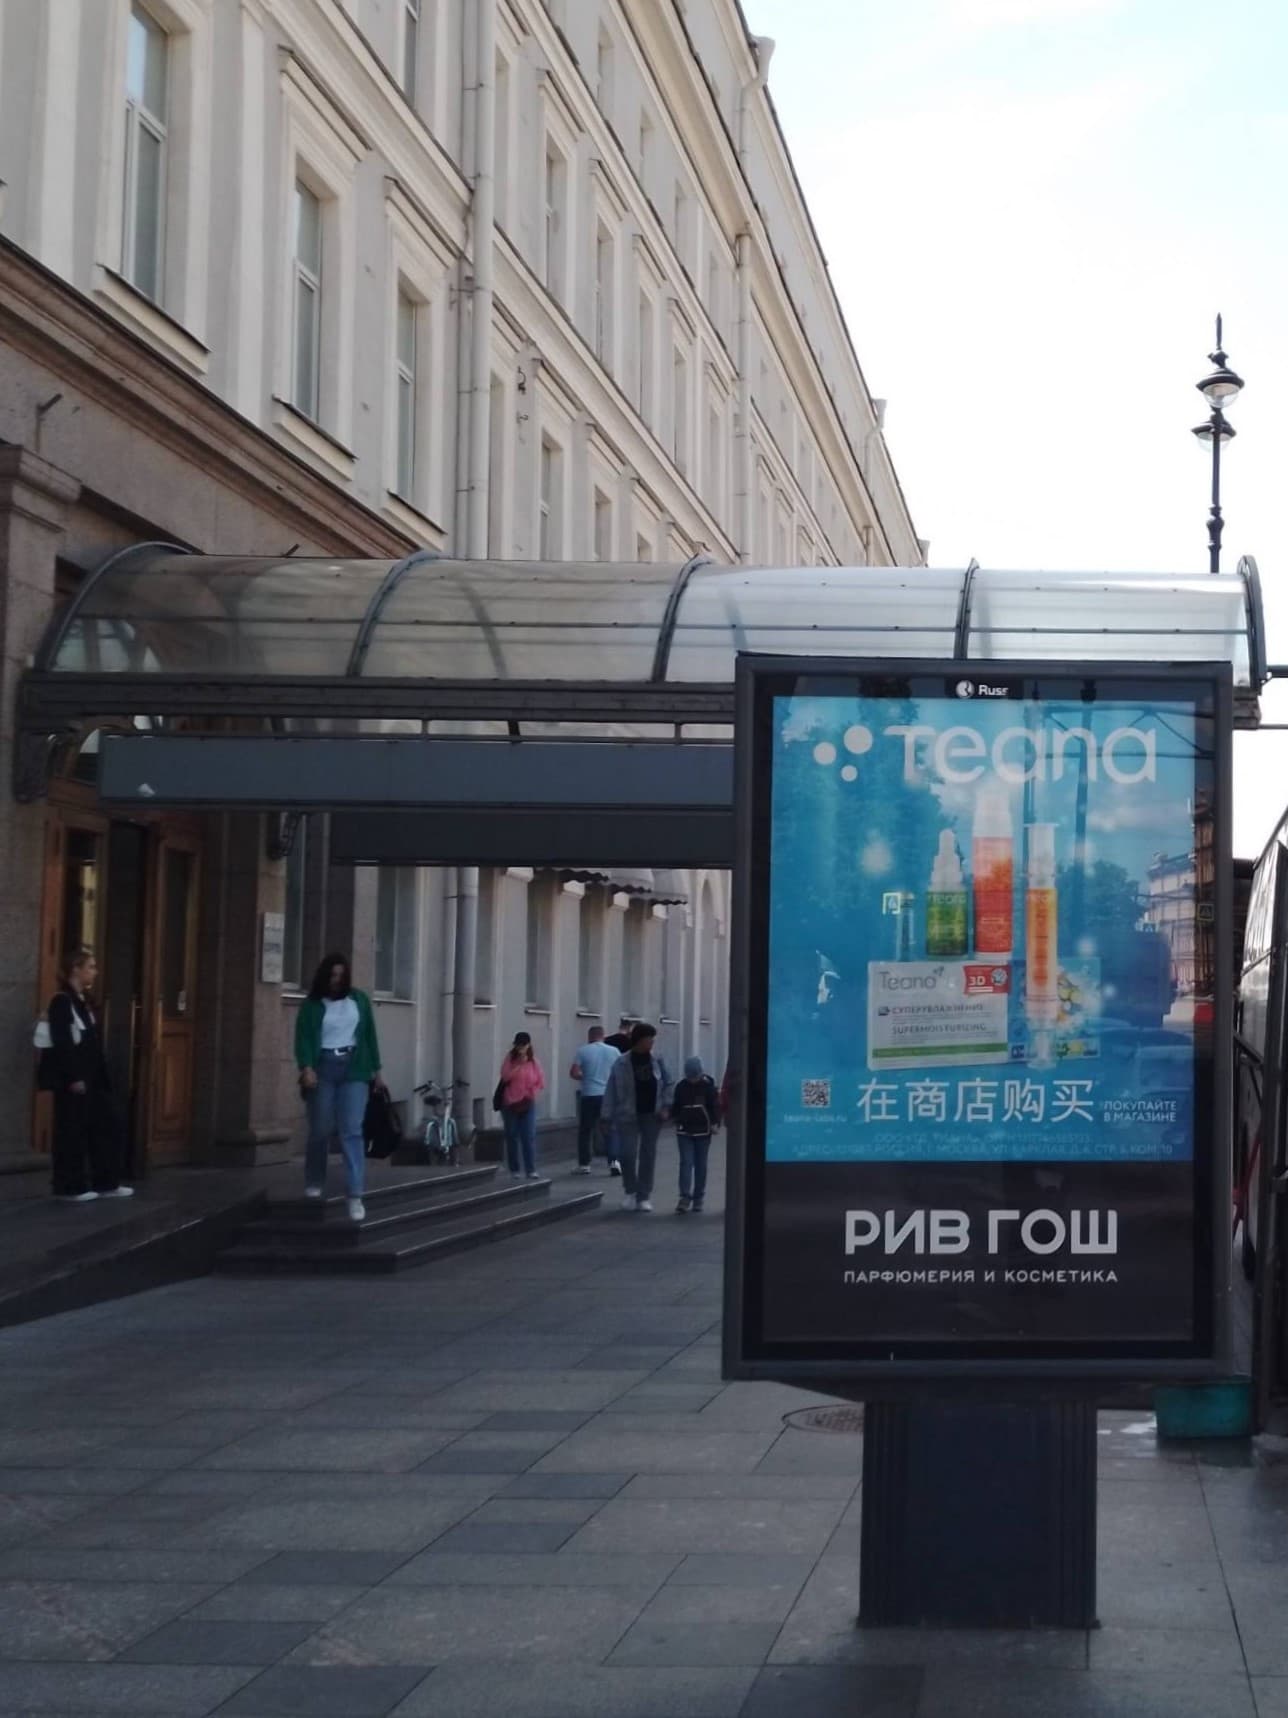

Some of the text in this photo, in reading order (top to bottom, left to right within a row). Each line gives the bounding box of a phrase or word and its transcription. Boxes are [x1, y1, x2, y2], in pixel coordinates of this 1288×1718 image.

[857, 1077, 1095, 1123] 在商店购买
[1104, 1098, 1177, 1111] ПОКУПАЙТЕ
[1104, 1111, 1177, 1123] В МАГАЗИНЕ
[845, 1210, 1118, 1255] РИВ ГОШ
[844, 1270, 1118, 1284] ПАРФЮМЕРИЯ И КОСМЕТИКА
